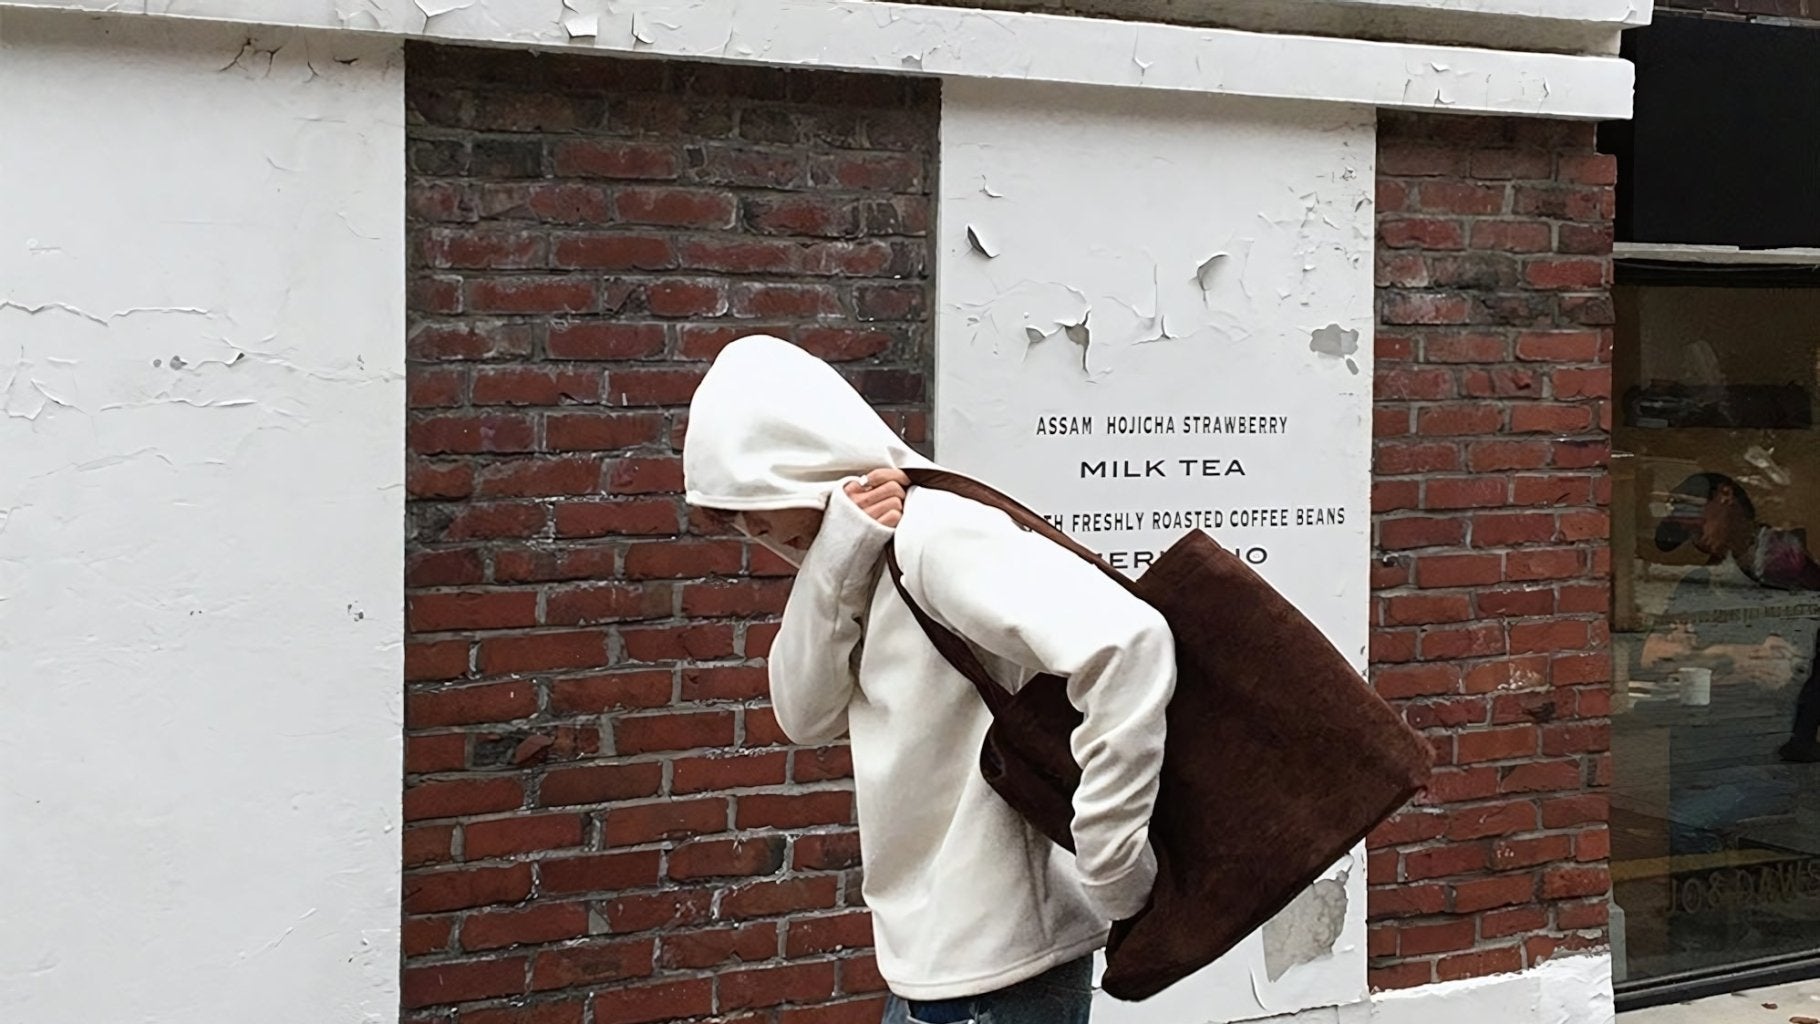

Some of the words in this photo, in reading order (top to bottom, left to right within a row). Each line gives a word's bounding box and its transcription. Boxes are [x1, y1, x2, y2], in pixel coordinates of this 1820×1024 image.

[1036, 416, 1092, 435] ASSAM
[1107, 416, 1175, 434] HOJICHA
[1183, 416, 1288, 434] STRAWBERRY
[1080, 460, 1166, 478] MILK
[1178, 459, 1246, 476] TEA
[1072, 512, 1144, 533] FRESHLY
[1152, 511, 1223, 530] ROASTED
[1229, 509, 1289, 528] COFFEE
[1296, 507, 1345, 526] BEANS
